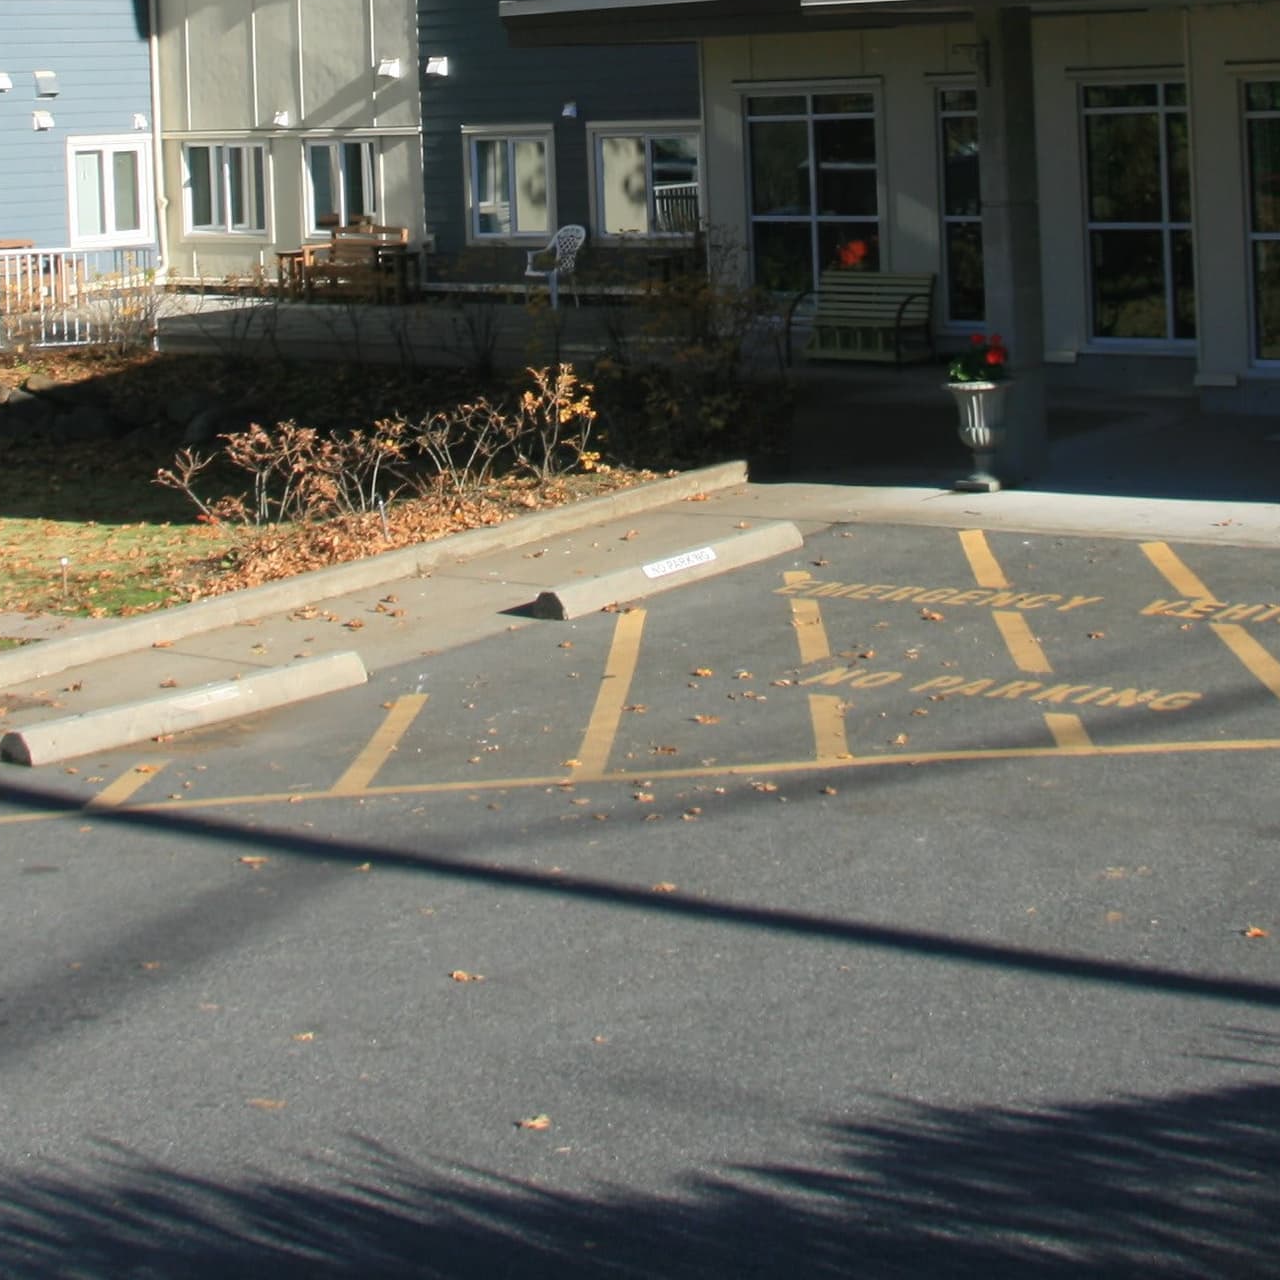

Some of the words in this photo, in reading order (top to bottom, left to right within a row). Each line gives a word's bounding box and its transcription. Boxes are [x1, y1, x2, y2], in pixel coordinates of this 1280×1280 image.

[773, 580, 1105, 611] EMERGENCY
[799, 666, 904, 689] NO
[909, 674, 1204, 712] PARKING
